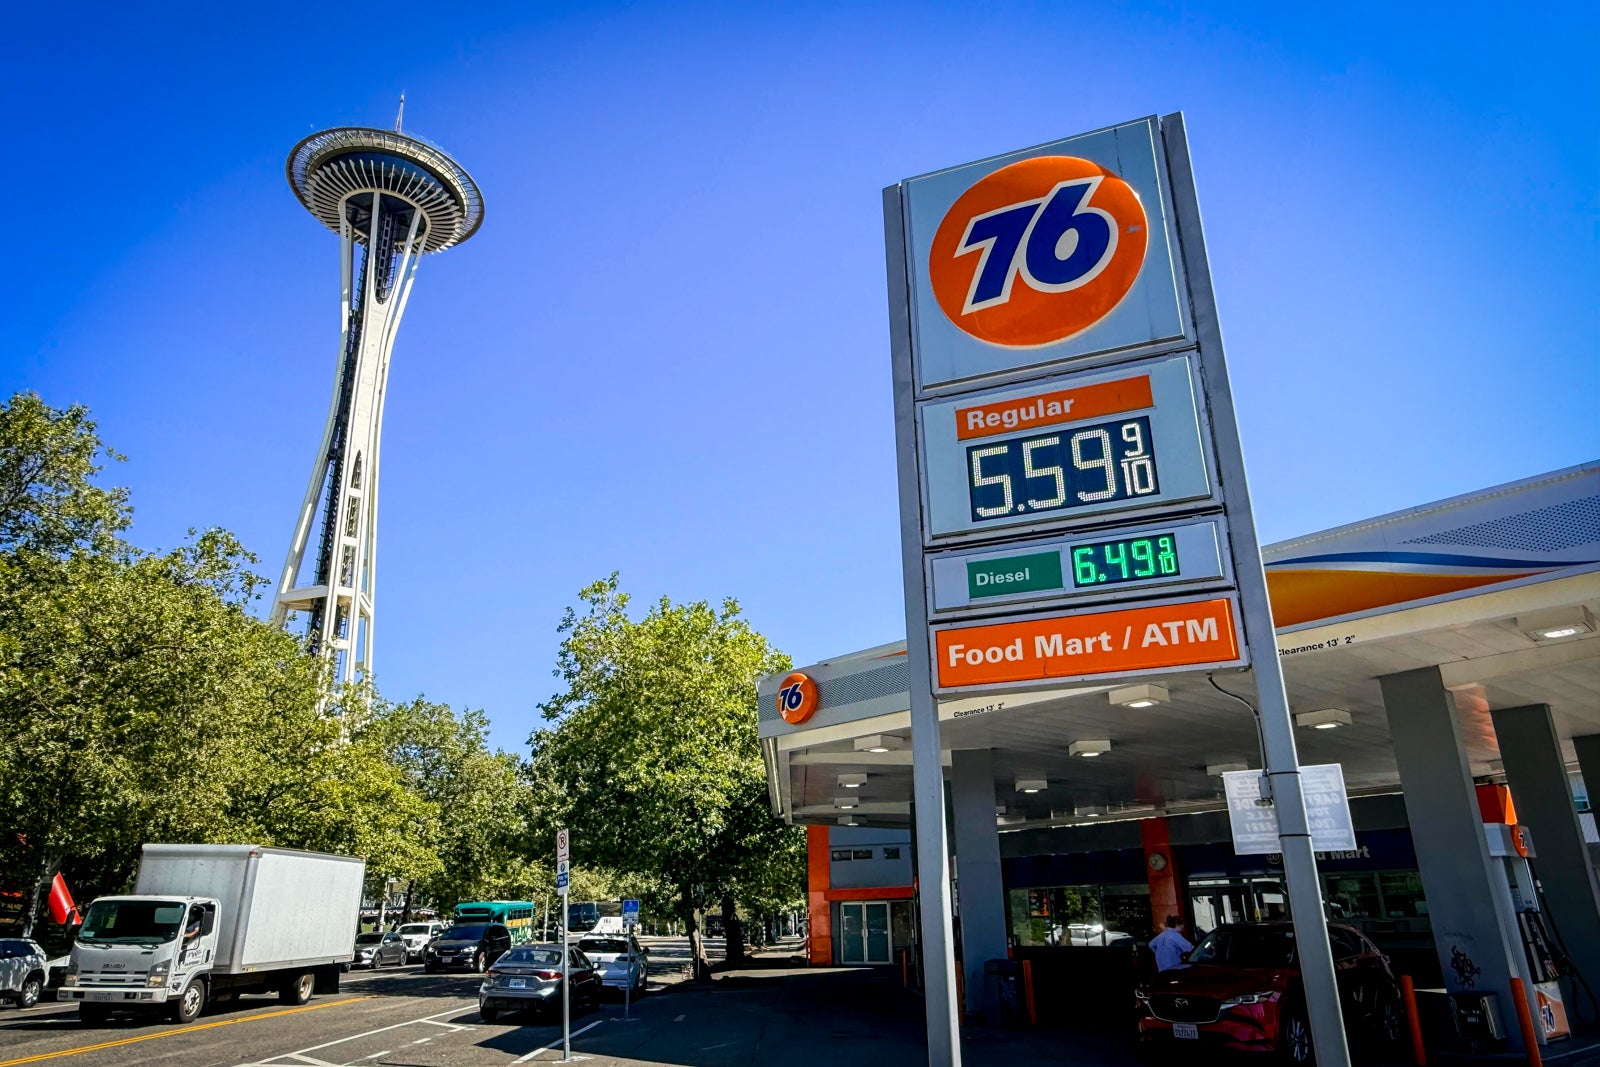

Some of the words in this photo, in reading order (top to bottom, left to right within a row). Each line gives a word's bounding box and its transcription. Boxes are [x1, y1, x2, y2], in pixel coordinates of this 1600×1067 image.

[953, 175, 1119, 316] 76
[966, 397, 1074, 431] Regular
[971, 428, 1117, 518] 5.59
[975, 567, 1030, 586] Diesel
[1073, 539, 1155, 585] 6.49
[948, 638, 1024, 667] Food
[1035, 630, 1113, 659] Mart
[1142, 617, 1219, 648] ATM
[778, 681, 804, 720] 76
[953, 707, 985, 718] Clearance
